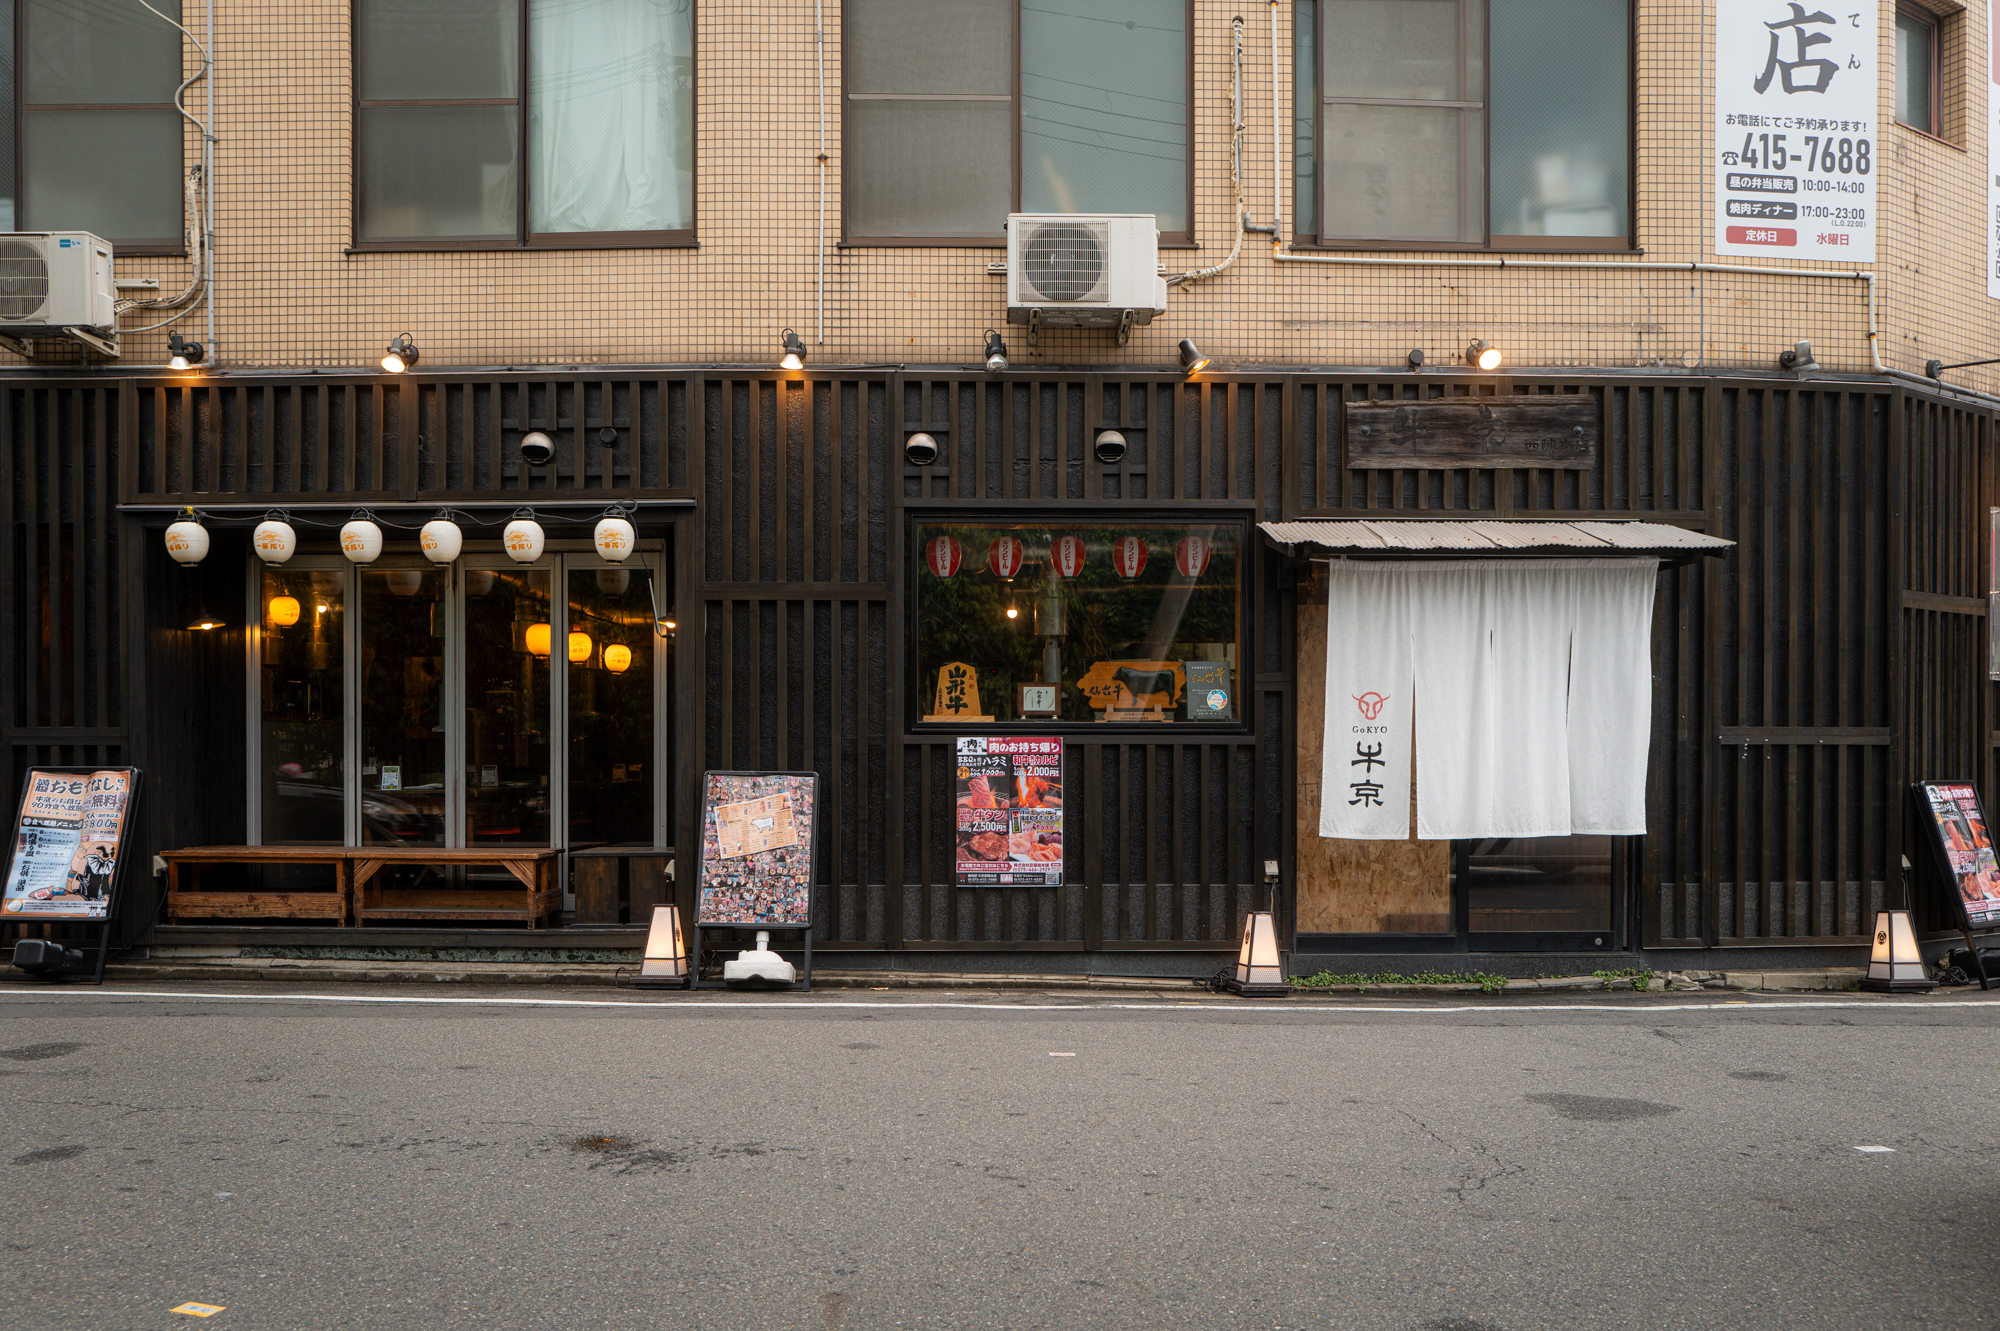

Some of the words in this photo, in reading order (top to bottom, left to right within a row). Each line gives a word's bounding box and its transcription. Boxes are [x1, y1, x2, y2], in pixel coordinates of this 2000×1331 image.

[1753, 2, 1840, 95] 店
[1725, 113, 1867, 132] お電話にてご予約承ります!
[1741, 132, 1870, 175] 415-7688
[1730, 176, 1794, 191] 昼の弁当販売
[1802, 179, 1865, 194] 10:00-14:00
[1729, 203, 1794, 216] 焼肉ディナー
[1801, 205, 1865, 220] 17:00-23:00
[1745, 230, 1777, 243] 定休日
[1816, 232, 1850, 246] 水曜日
[256, 542, 285, 551] 一番搾り
[945, 665, 968, 715] 山形牛
[1088, 683, 1124, 702] 仙台牛
[989, 742, 1060, 753] 肉のお持ち帰り
[983, 756, 1007, 766] ハラミ
[1035, 755, 1058, 765] カルビ
[1348, 741, 1385, 808] 牛京
[974, 810, 1005, 820] 牛タン
